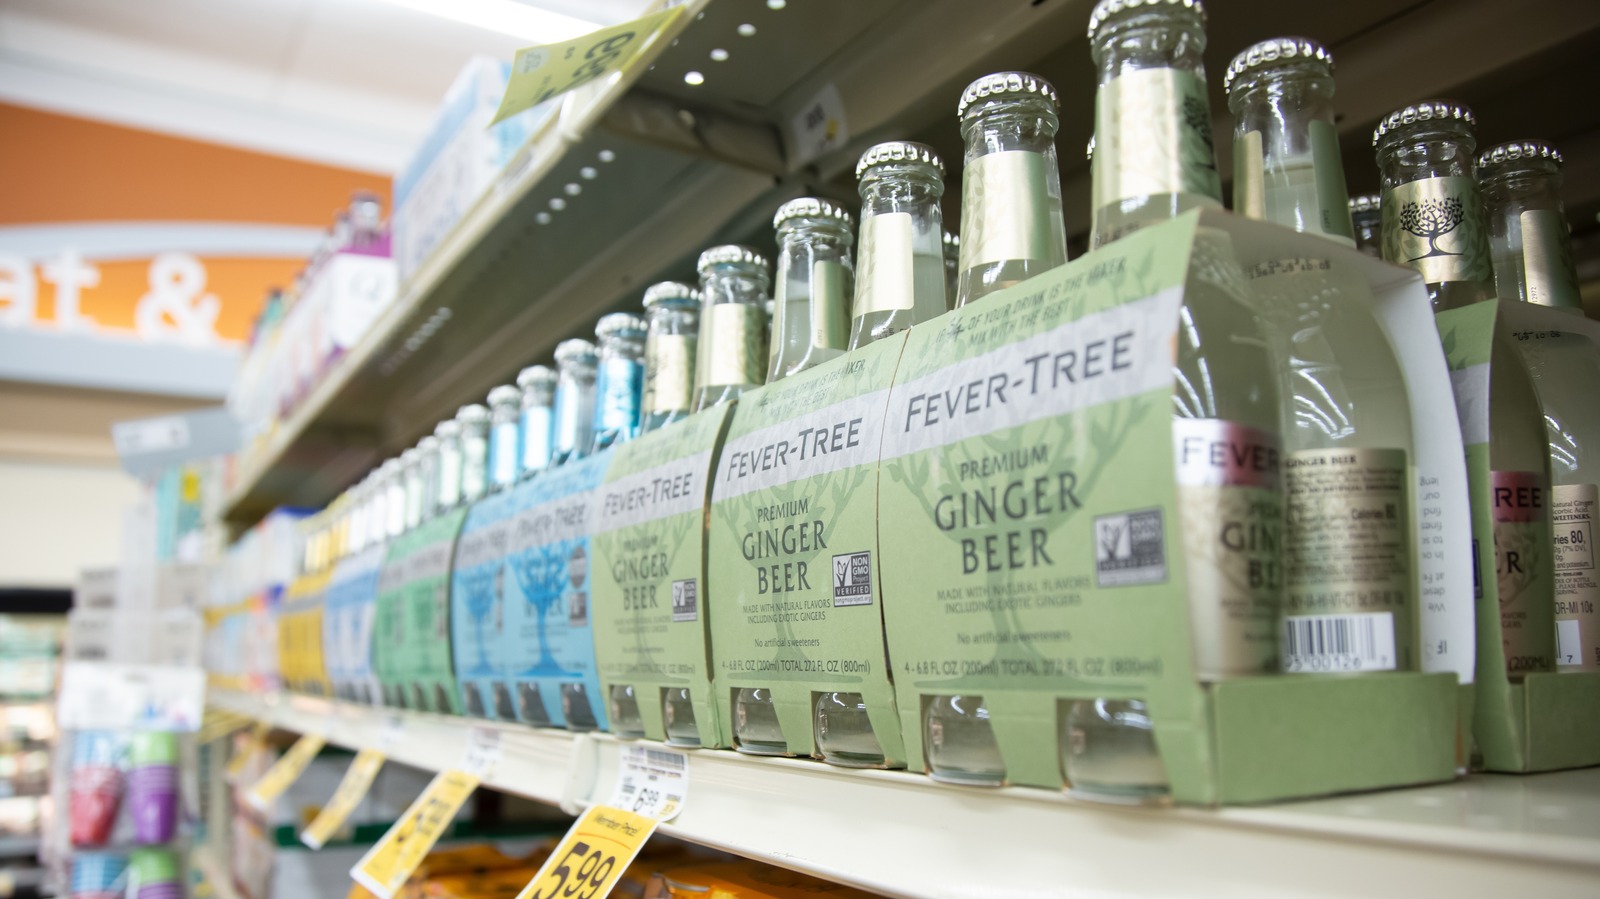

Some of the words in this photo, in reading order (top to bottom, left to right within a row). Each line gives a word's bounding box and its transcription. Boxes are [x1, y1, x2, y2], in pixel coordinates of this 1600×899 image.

[134, 250, 222, 345] &
[983, 304, 1010, 323] YOUR
[1065, 277, 1083, 293] THE
[904, 331, 1135, 433] FEVER-TREE
[727, 417, 863, 482] FEVER-TREE
[960, 444, 1049, 482] PREMIUM
[602, 472, 693, 518] FEVER-TREE
[934, 470, 1083, 532] GINGER
[757, 498, 809, 523] PREMIUM
[742, 520, 827, 561] GINGER
[960, 527, 1055, 575] BEER
[613, 553, 669, 584] GINGER
[852, 557, 868, 566] NON
[852, 566, 869, 575] GMO
[758, 561, 812, 595] BEER
[836, 585, 870, 596] VERIFIED
[623, 585, 659, 611] BEER
[743, 604, 759, 614] MADE
[760, 603, 774, 612] WITH
[775, 601, 803, 611] NATURAL
[804, 599, 831, 609] FLAVORS
[748, 614, 778, 624] INCLUDING
[778, 612, 799, 623] EXOTIC
[800, 611, 826, 621] GINGERS
[755, 638, 764, 647] No
[764, 637, 787, 647] artificial
[787, 638, 820, 647] sweeteners
[957, 633, 971, 644] No
[745, 660, 755, 670] OZ
[756, 659, 780, 672] (200ml)
[780, 660, 804, 672] TOTAL
[817, 660, 825, 672] FL
[826, 660, 839, 673] OZ
[840, 659, 871, 674] (800ml)
[942, 660, 958, 677] OZ
[1566, 654, 1573, 663] 7
